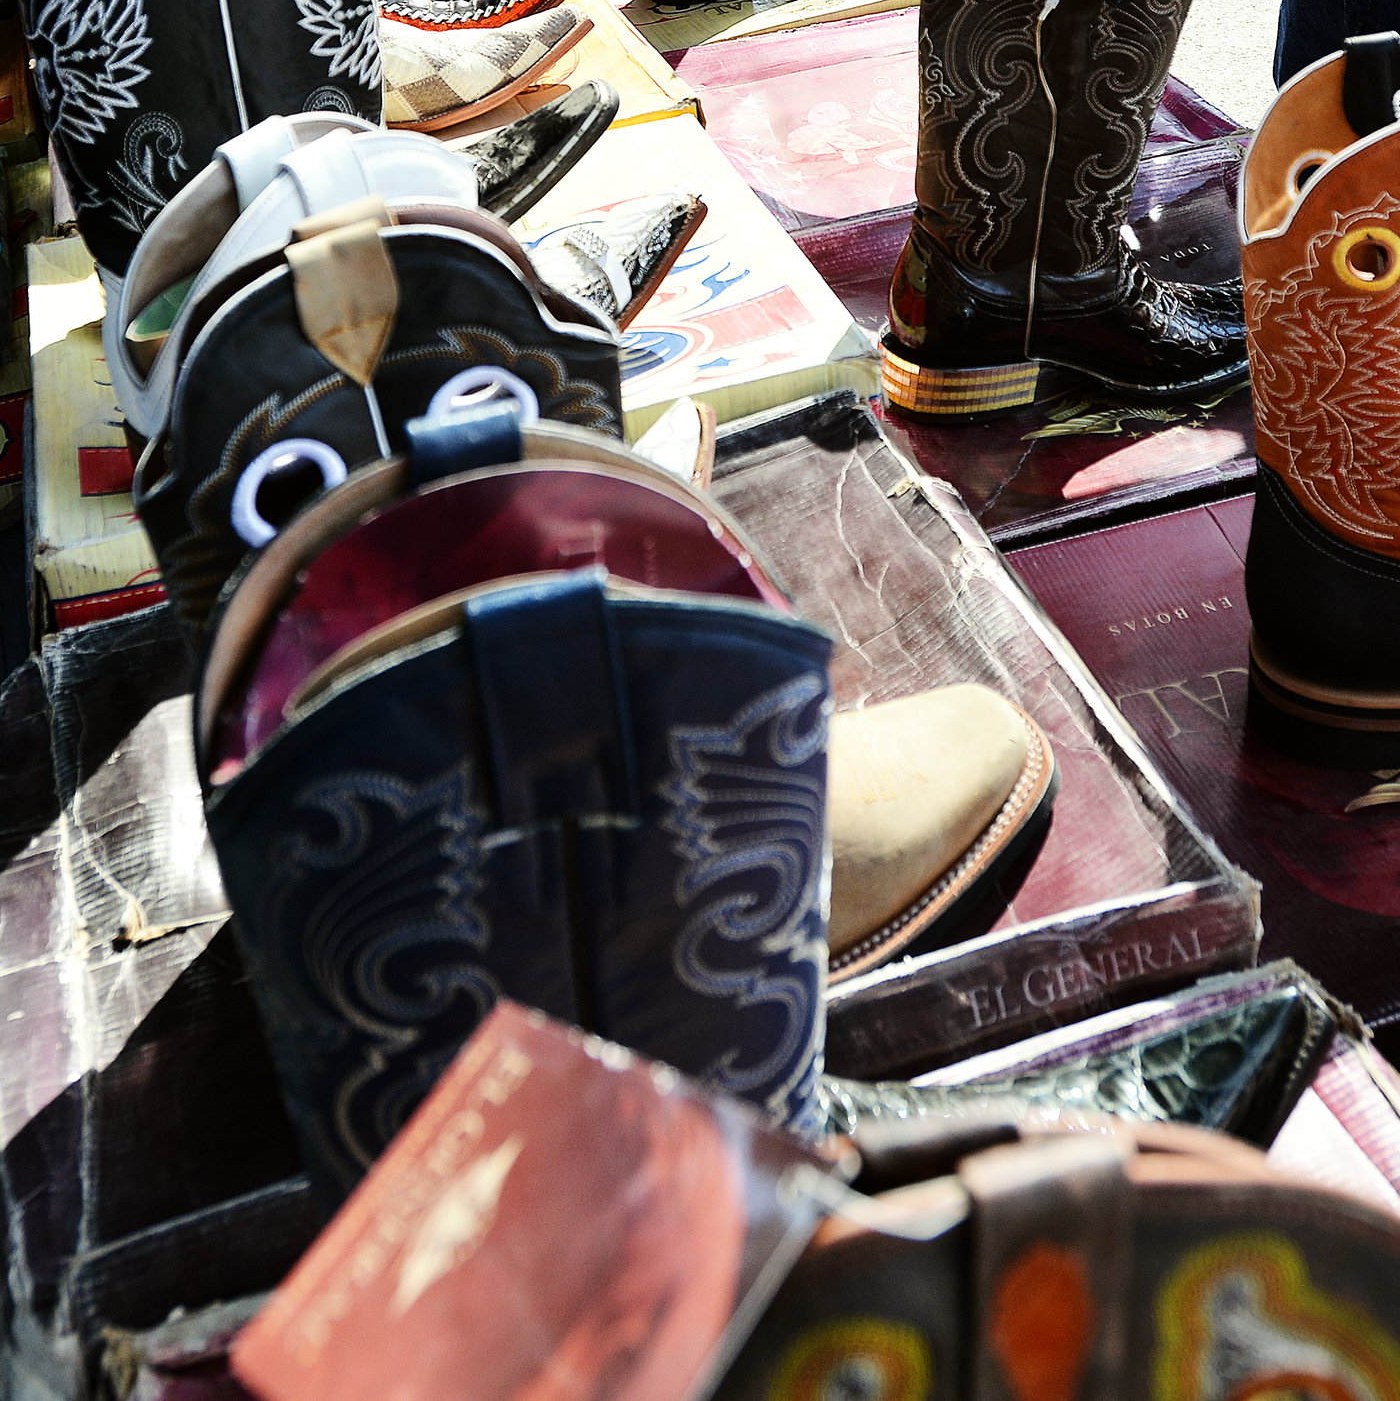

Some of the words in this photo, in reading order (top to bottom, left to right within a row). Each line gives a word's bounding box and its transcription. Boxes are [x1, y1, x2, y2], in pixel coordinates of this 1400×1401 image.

[1159, 242, 1213, 263] TODA
[1201, 596, 1233, 615] EN
[1108, 606, 1190, 637] BOTAS
[968, 984, 1021, 1028] EL
[1023, 928, 1216, 1008] GENERAL
